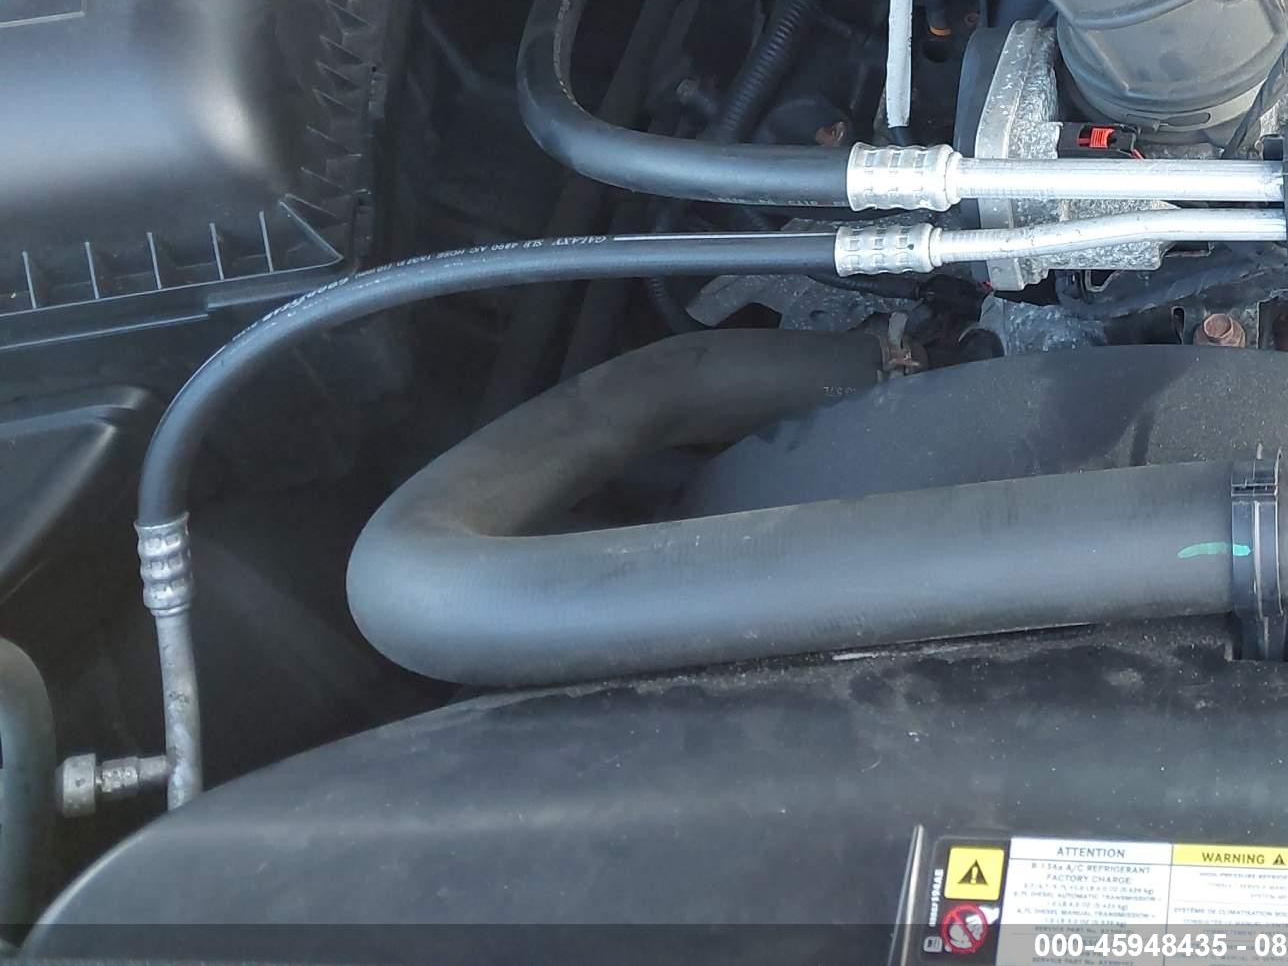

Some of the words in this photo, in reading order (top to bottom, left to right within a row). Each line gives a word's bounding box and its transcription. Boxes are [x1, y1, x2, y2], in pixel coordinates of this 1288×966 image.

[1056, 846, 1126, 858] ATTENTION
[1201, 851, 1265, 865] WARNING
[1065, 863, 1085, 873] A/C
[1086, 864, 1151, 874] REFRIGERANT
[1046, 873, 1089, 883] FACTORY
